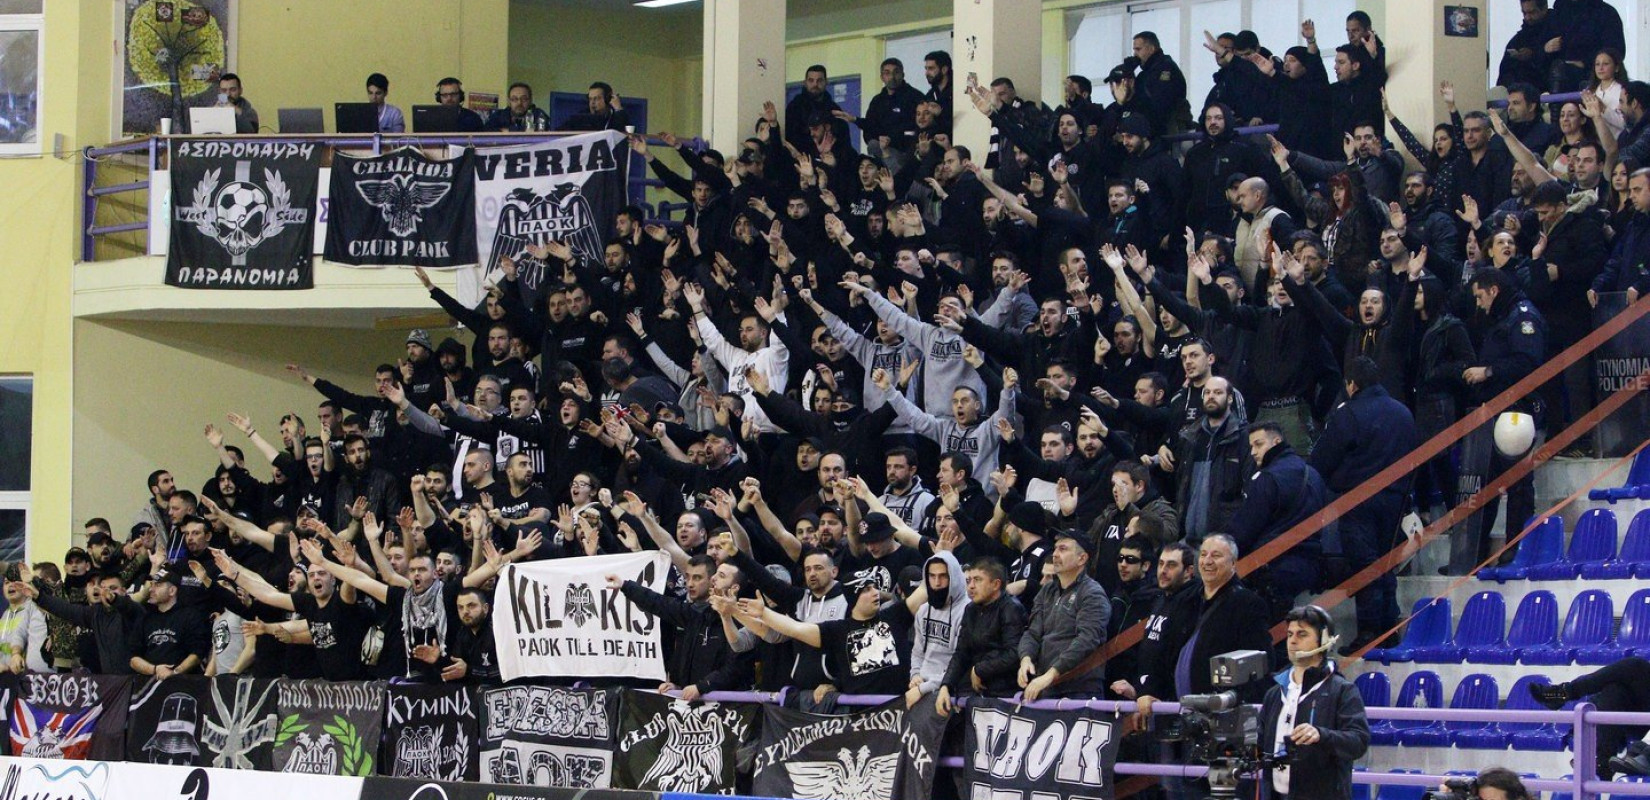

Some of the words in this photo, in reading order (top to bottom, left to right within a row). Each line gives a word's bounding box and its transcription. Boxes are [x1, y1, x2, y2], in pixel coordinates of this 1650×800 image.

[178, 141, 315, 160] ΑΣΠΡΟΜΑΥΡΗ
[474, 138, 618, 182] VERIA
[352, 156, 454, 178] CHALKIDA
[520, 217, 574, 233] ΠΑΟΚ
[348, 239, 397, 257] CLUB
[178, 266, 300, 285] ΠΑΡΑΝΟΜΙΑ
[518, 637, 561, 657] PAOK
[565, 637, 599, 657] TILL
[603, 639, 657, 659] DEATH
[620, 712, 668, 752] CLUB
[971, 707, 1112, 787] ΠΑΟΚ
